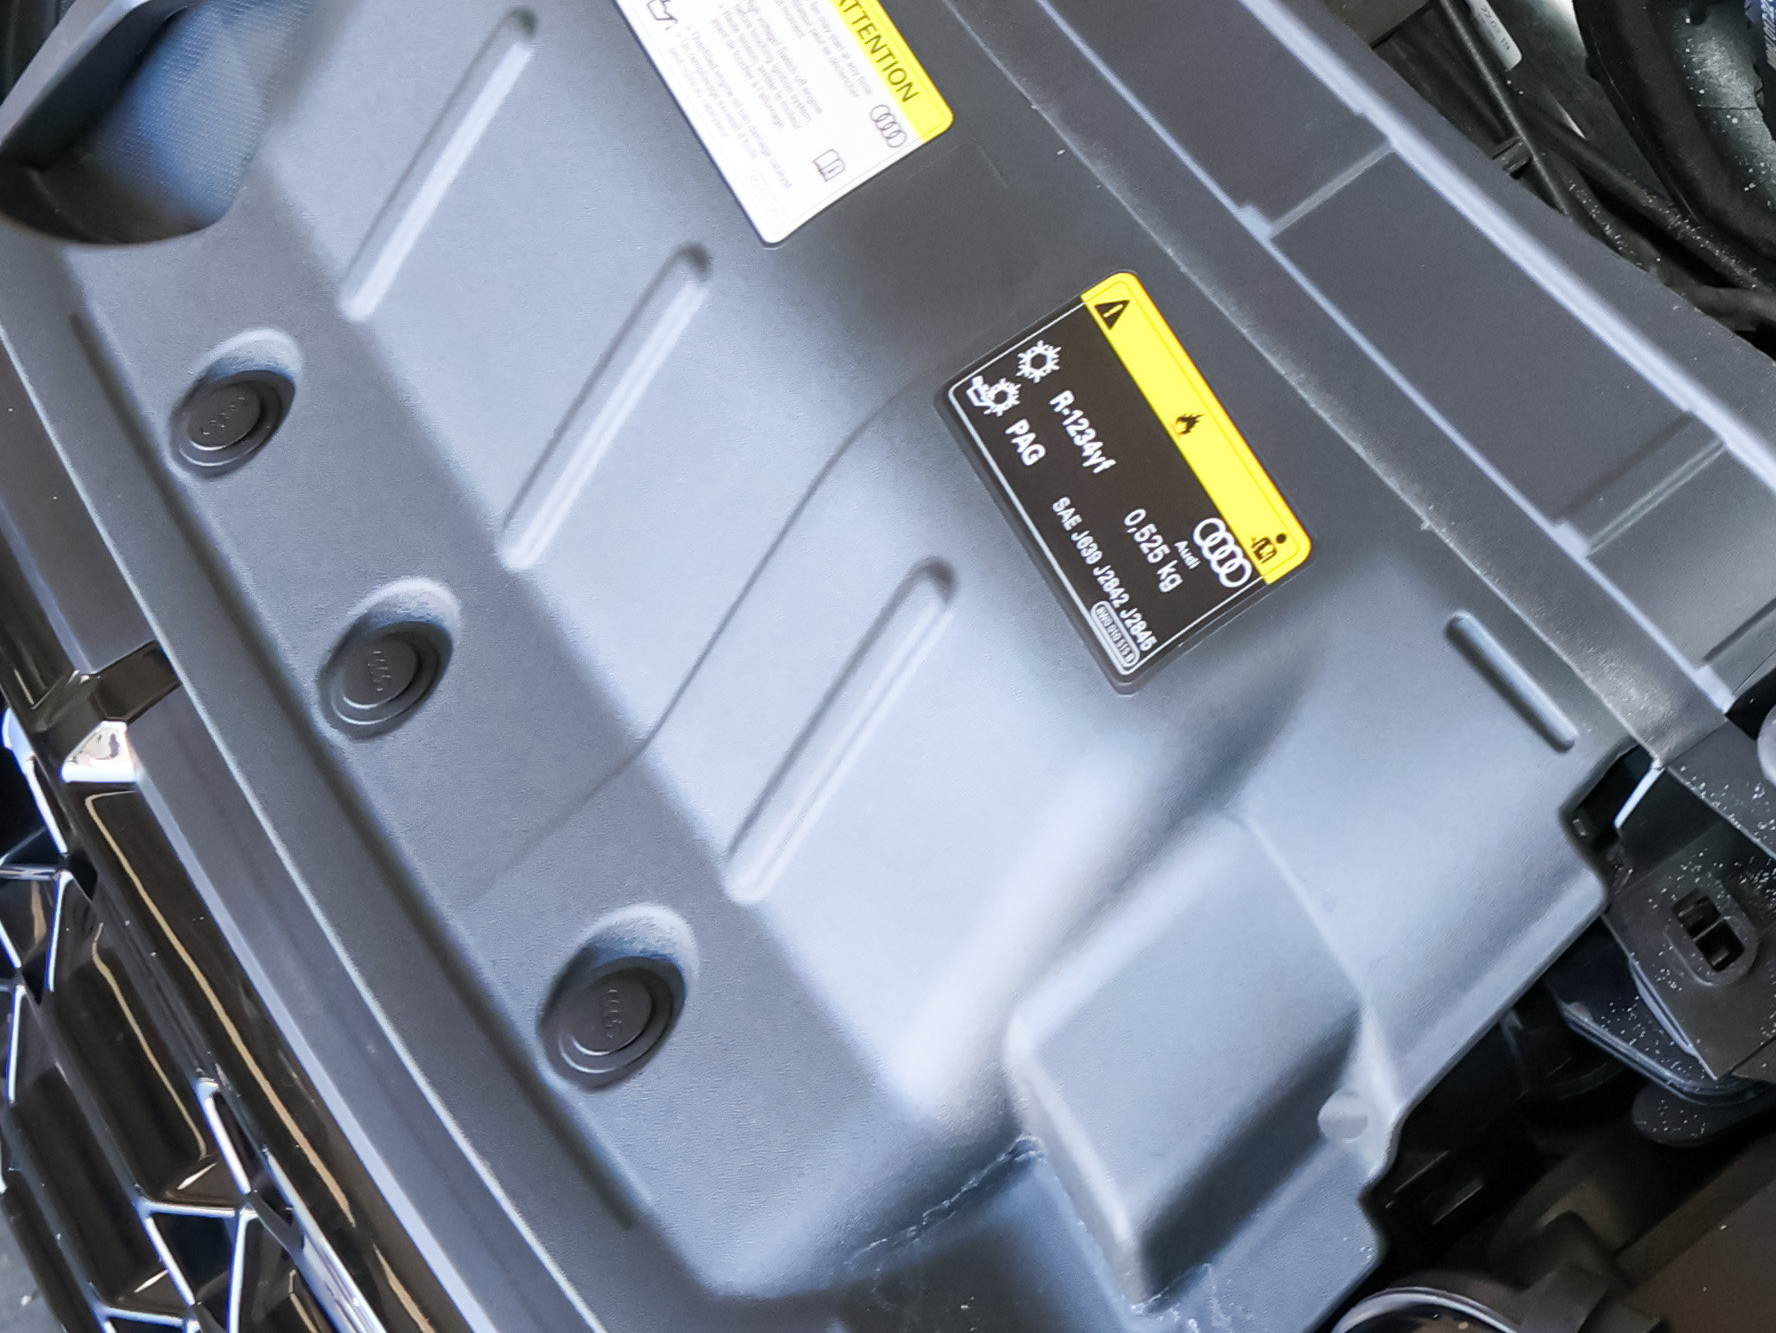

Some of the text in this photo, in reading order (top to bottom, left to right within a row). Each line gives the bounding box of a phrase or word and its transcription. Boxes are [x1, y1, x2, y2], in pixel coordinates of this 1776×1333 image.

[1003, 416, 1048, 469] PAG
[1043, 386, 1186, 596] R-1234yf 0,525 kg
[1050, 493, 1158, 654] SAE J639 J2842 J2845
[1172, 536, 1201, 571] Audi
